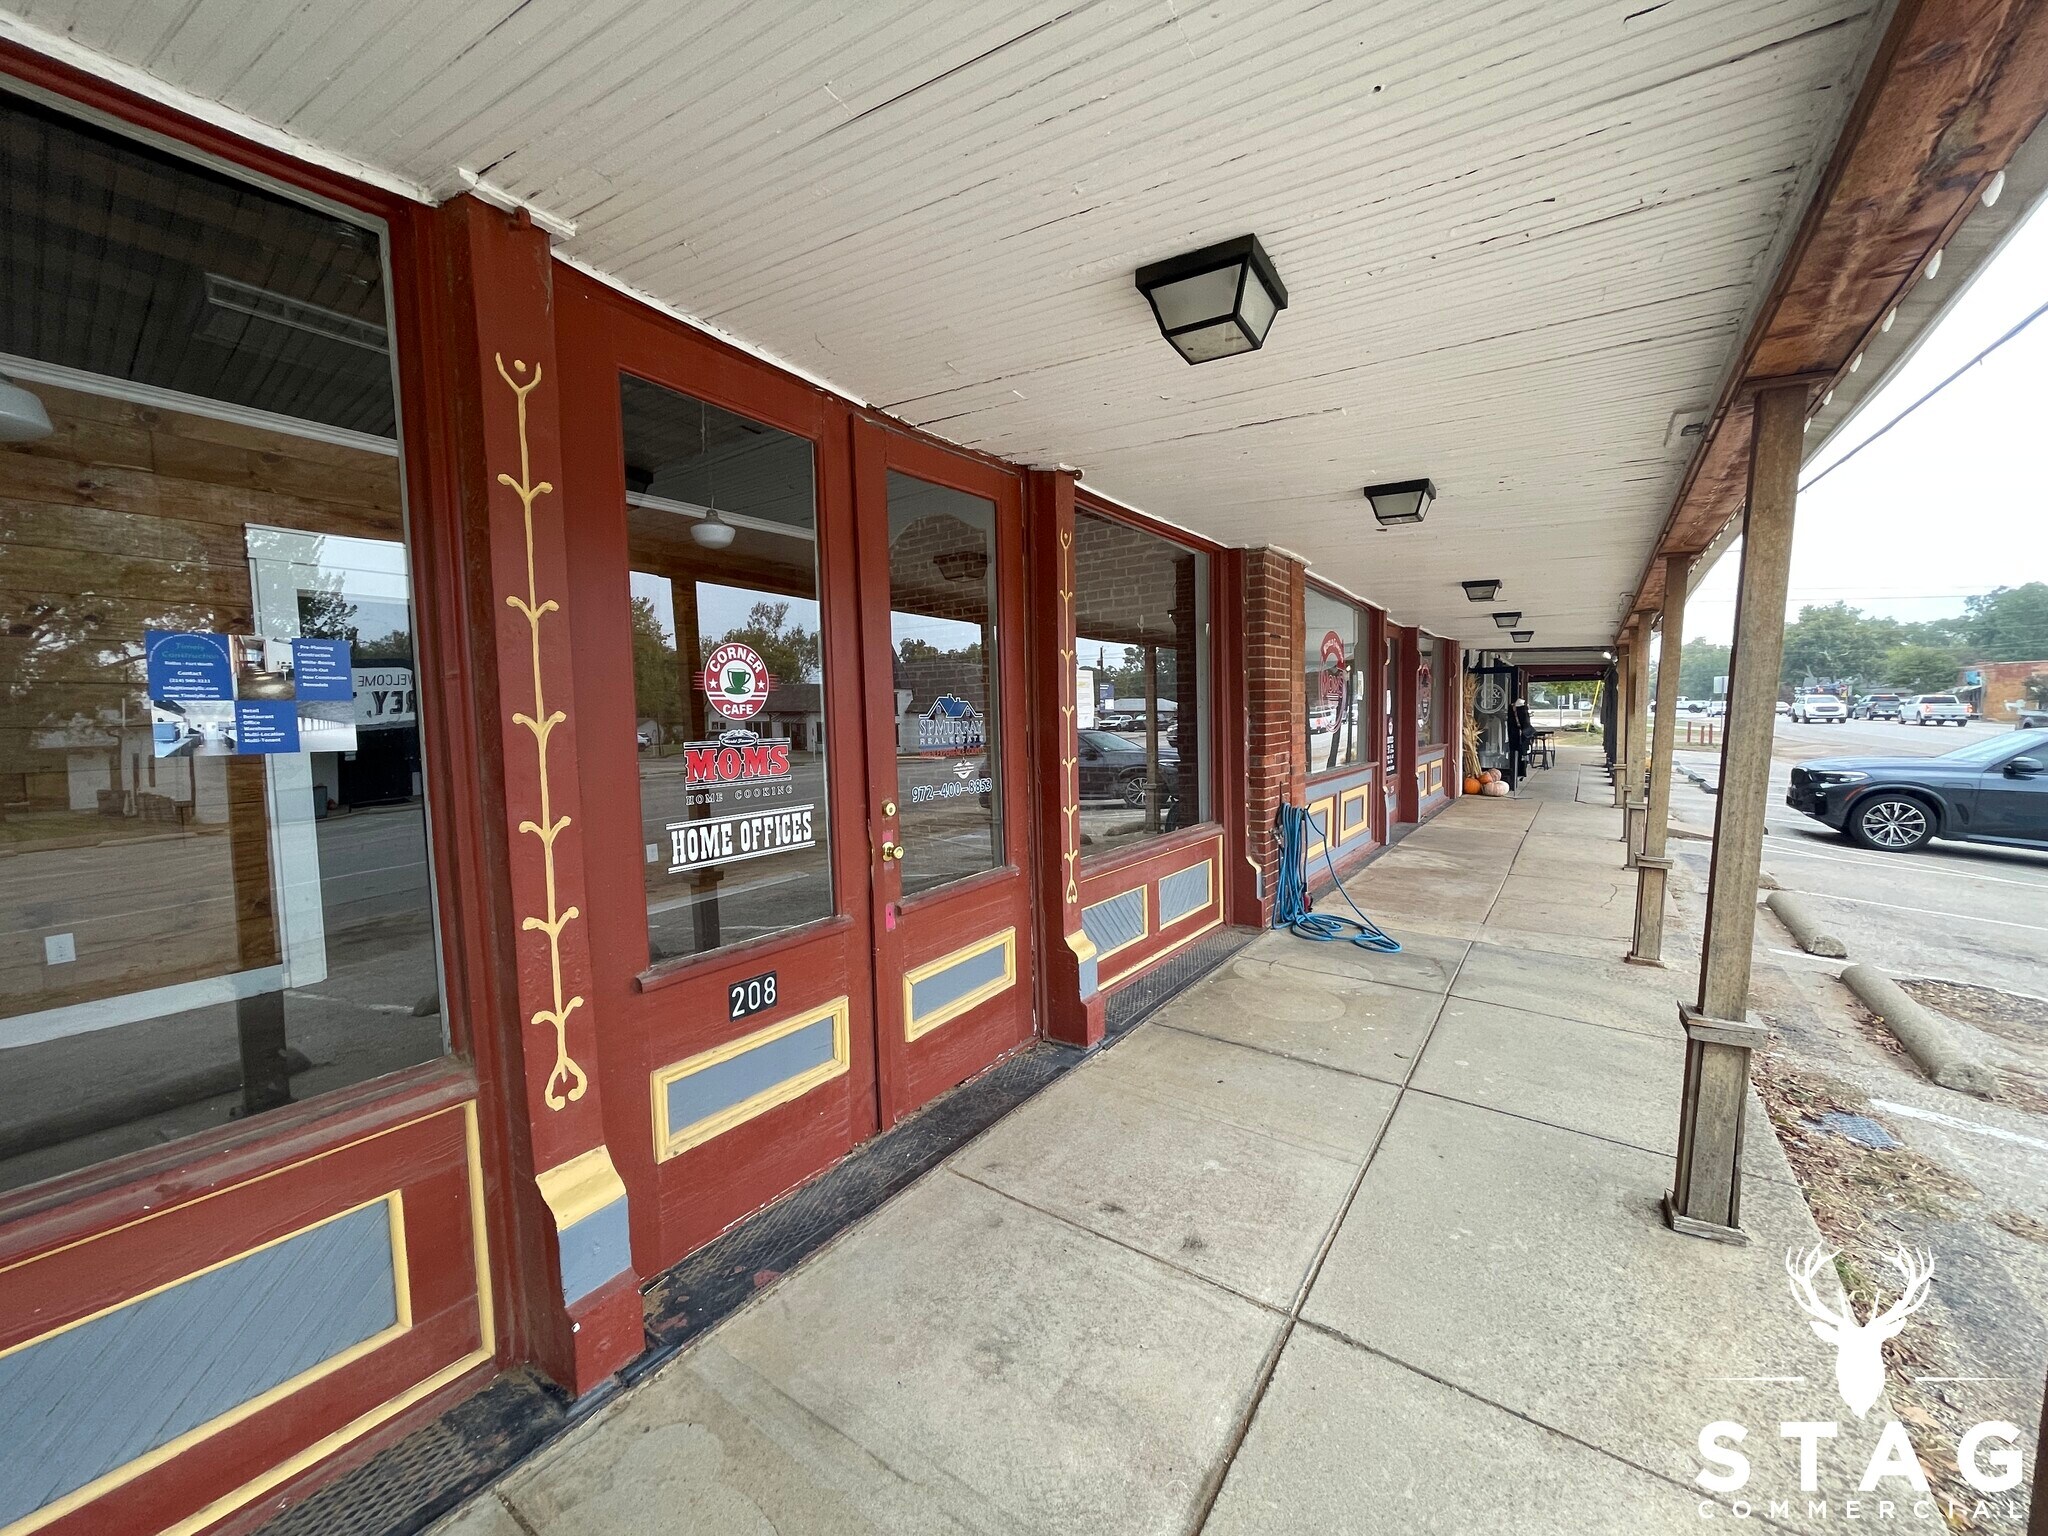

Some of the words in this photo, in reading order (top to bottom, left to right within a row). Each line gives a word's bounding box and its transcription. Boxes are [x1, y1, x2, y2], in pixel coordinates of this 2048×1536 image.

[709, 646, 763, 674] CORNER
[722, 704, 754, 715] CAFE
[919, 737, 946, 745] REAL
[949, 735, 984, 744] ESTATE
[683, 745, 790, 784] MOMS
[685, 792, 723, 806] HOME
[734, 784, 793, 800] COOKING
[912, 777, 992, 803] 972-400-8853
[671, 822, 733, 865] HOME
[740, 811, 812, 852] OFFICES
[731, 976, 776, 1017] 208
